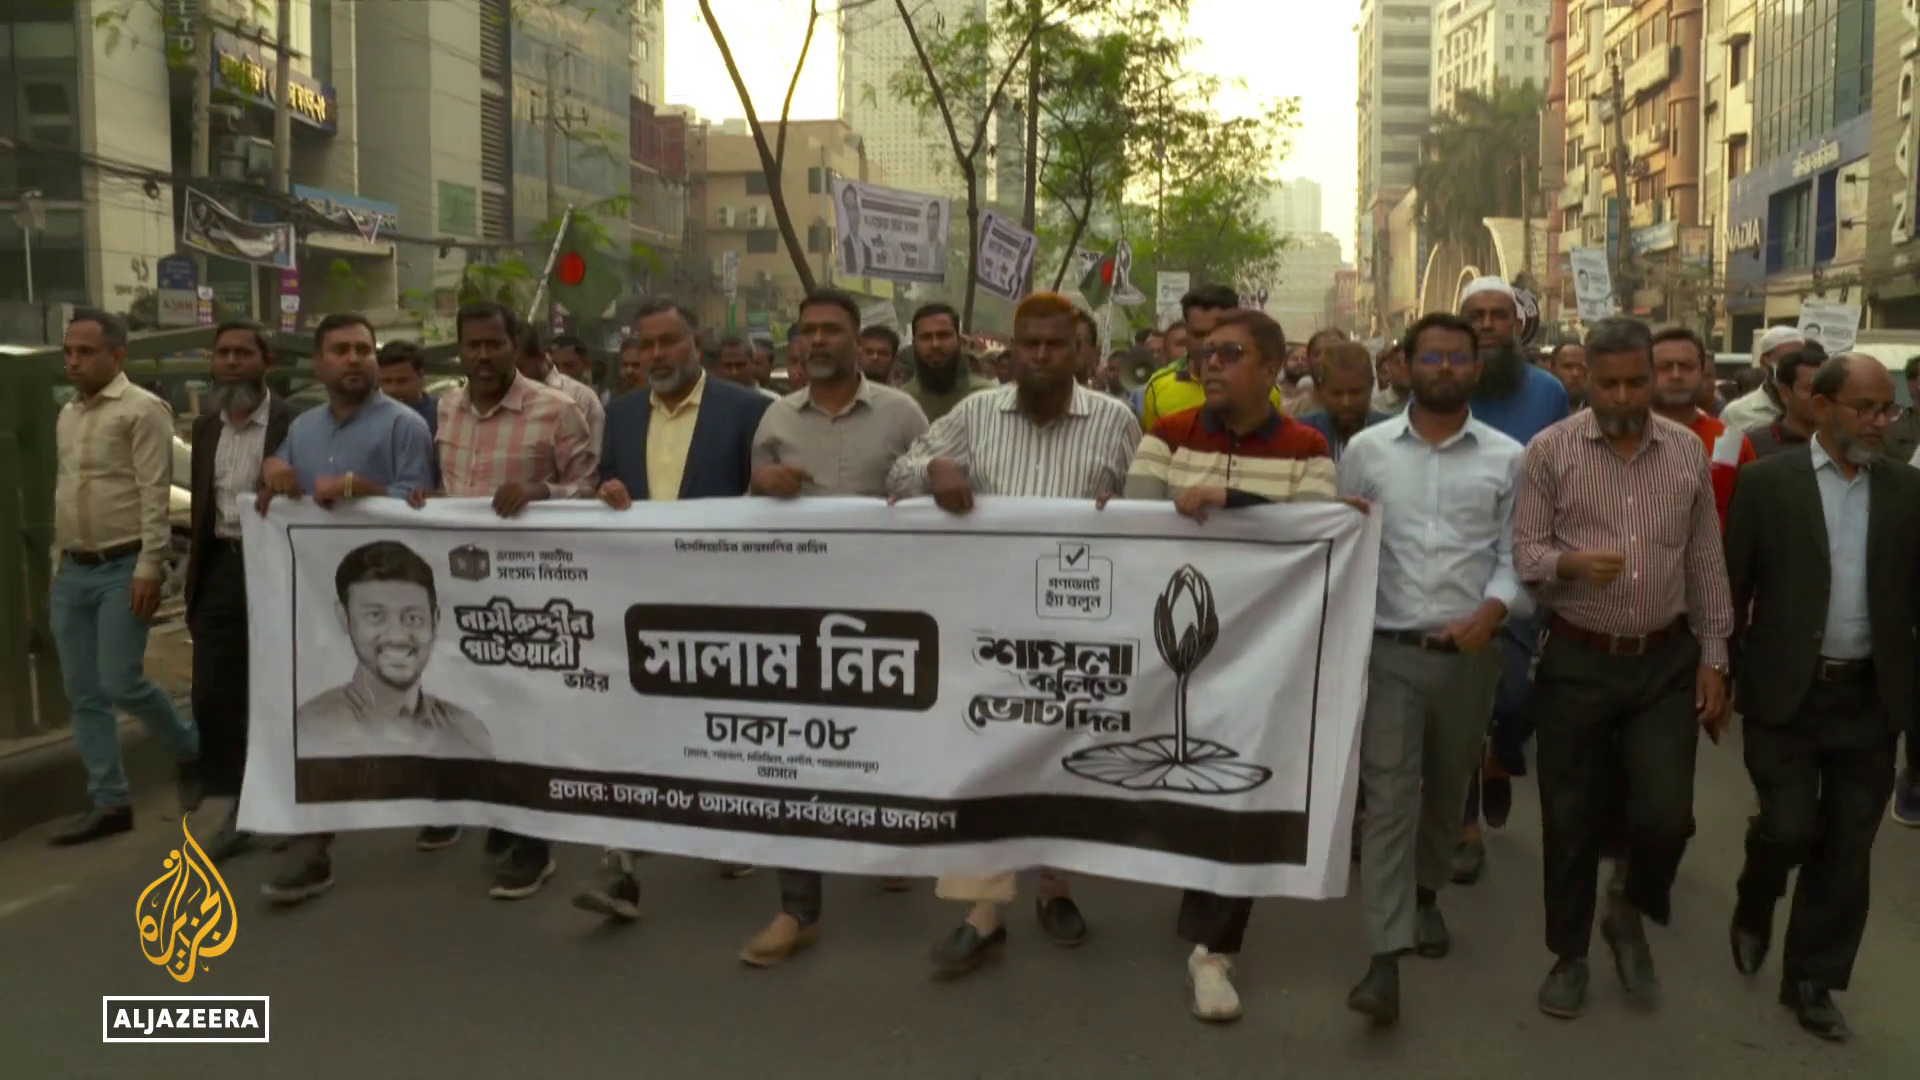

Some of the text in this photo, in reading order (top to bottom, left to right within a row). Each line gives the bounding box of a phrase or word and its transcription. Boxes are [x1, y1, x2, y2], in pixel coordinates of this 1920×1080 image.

[497, 562, 588, 581] সংসদ নির্বাচন
[639, 613, 919, 695] সালাম নিন
[976, 635, 1134, 678] শাপলা
[705, 712, 857, 751] ঢাকা-০৮
[549, 779, 958, 831] প্রচারে: ঢাকা-০৮ আসনের সর্বস্তরের জনগণ
